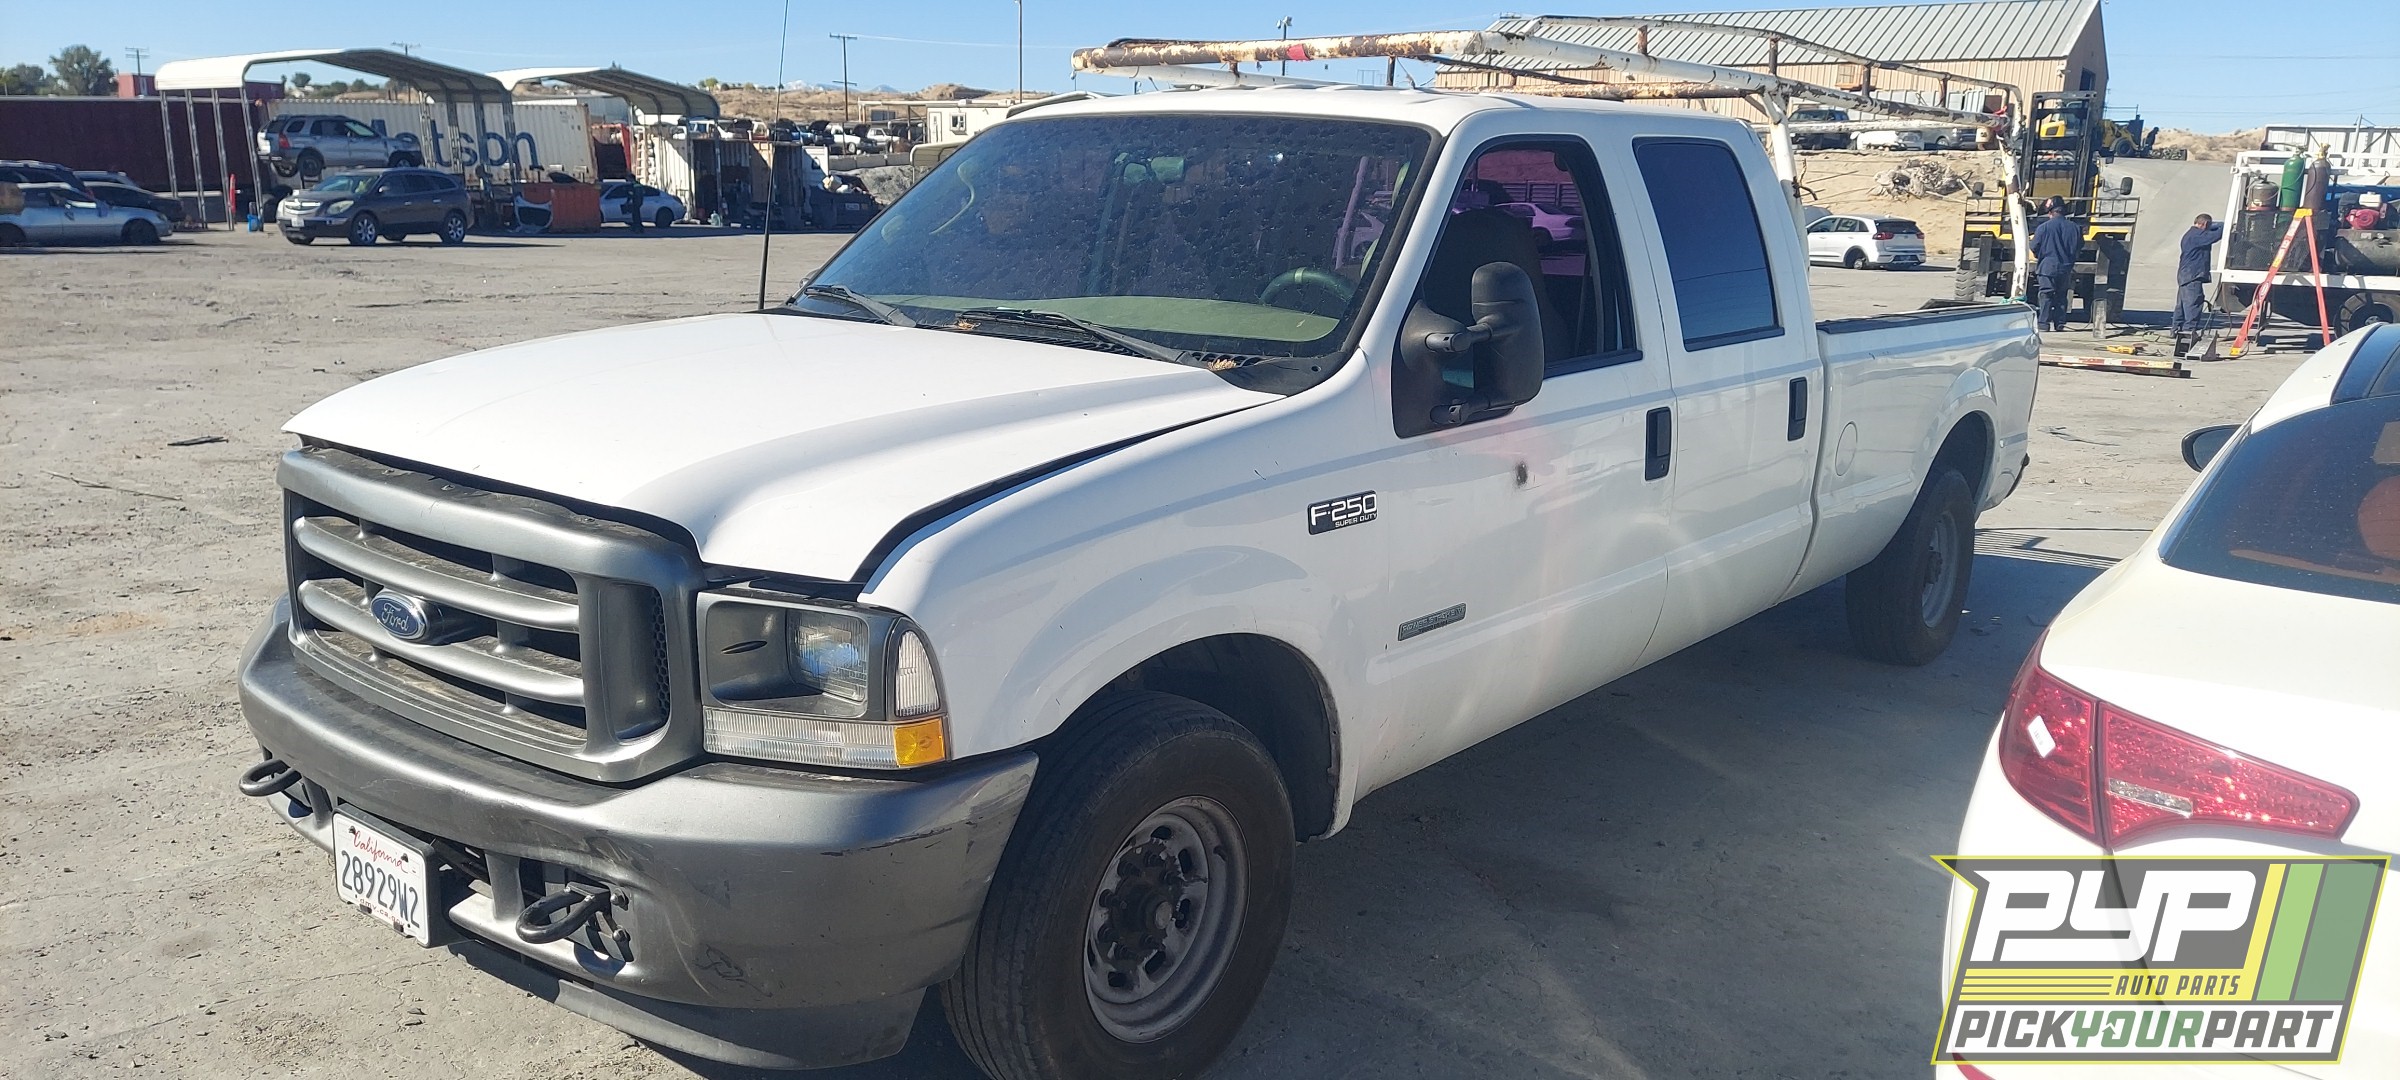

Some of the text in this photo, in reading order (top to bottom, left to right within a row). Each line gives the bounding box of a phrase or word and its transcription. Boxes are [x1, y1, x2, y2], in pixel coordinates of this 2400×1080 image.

[1335, 513, 1377, 528] SUPER DUTY
[381, 602, 410, 631] Ford
[353, 830, 408, 874] California
[341, 850, 420, 929] 28929W2
